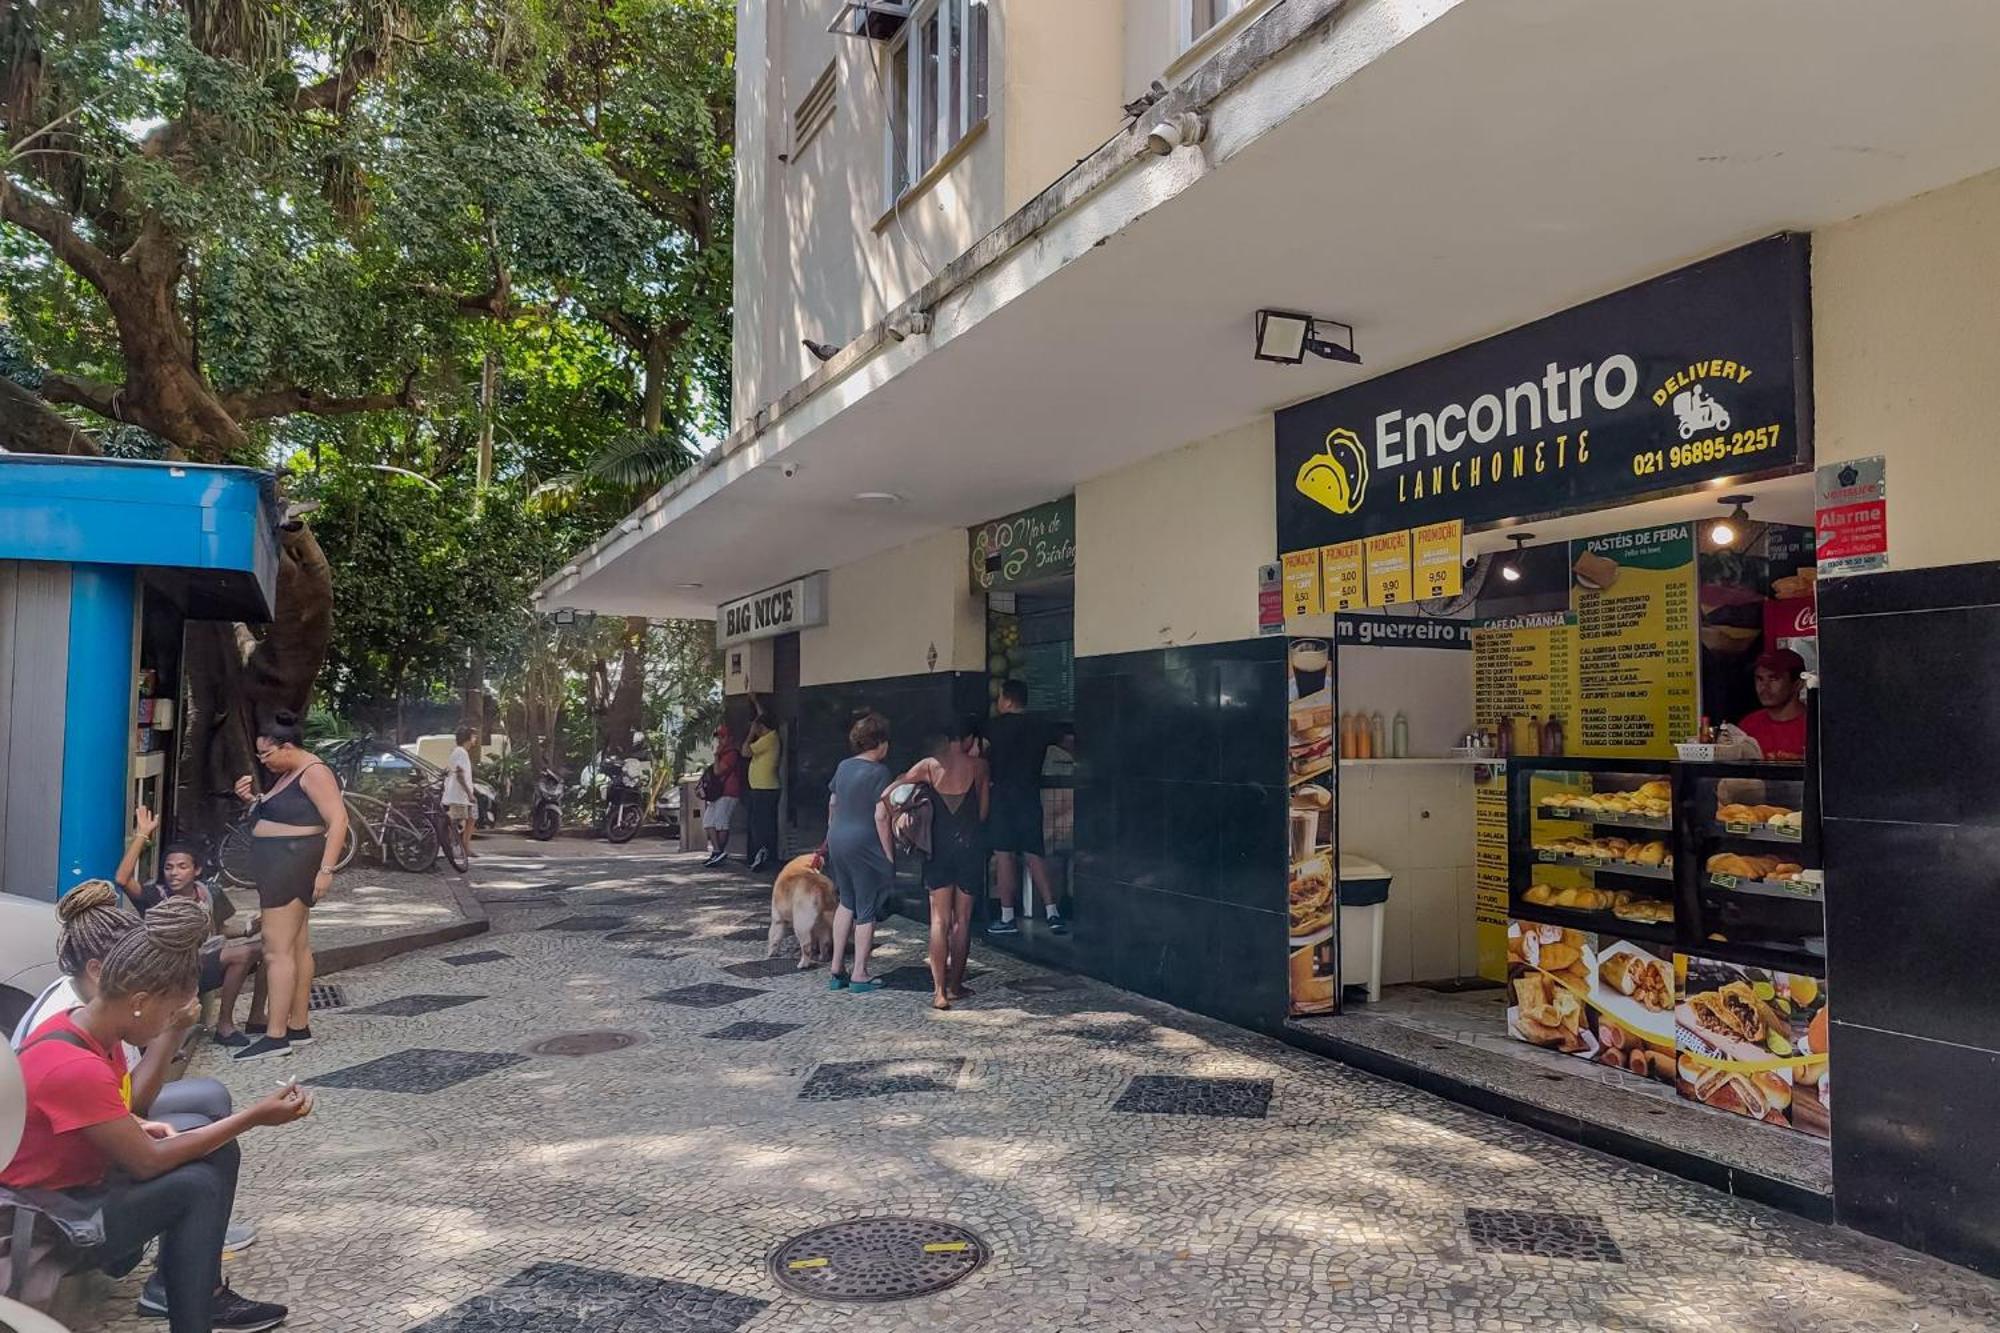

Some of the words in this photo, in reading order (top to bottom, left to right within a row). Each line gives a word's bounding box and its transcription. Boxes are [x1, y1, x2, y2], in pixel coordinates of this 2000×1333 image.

[1652, 359, 1752, 407] DELIVERY
[1376, 354, 1638, 469] Encontro
[1399, 430, 1589, 502] LANCHONETE
[1633, 450, 1663, 475] 021
[1669, 424, 1780, 469] 96895-2257
[1588, 533, 1633, 552] PASTÉIS
[1635, 532, 1651, 545] DE
[1653, 526, 1688, 541] FEIRA
[1820, 507, 1881, 528] Alarme
[1382, 580, 1399, 592] 9,90
[727, 602, 751, 637] BIG
[754, 589, 793, 629] NICE
[1359, 621, 1455, 644] guerreiro
